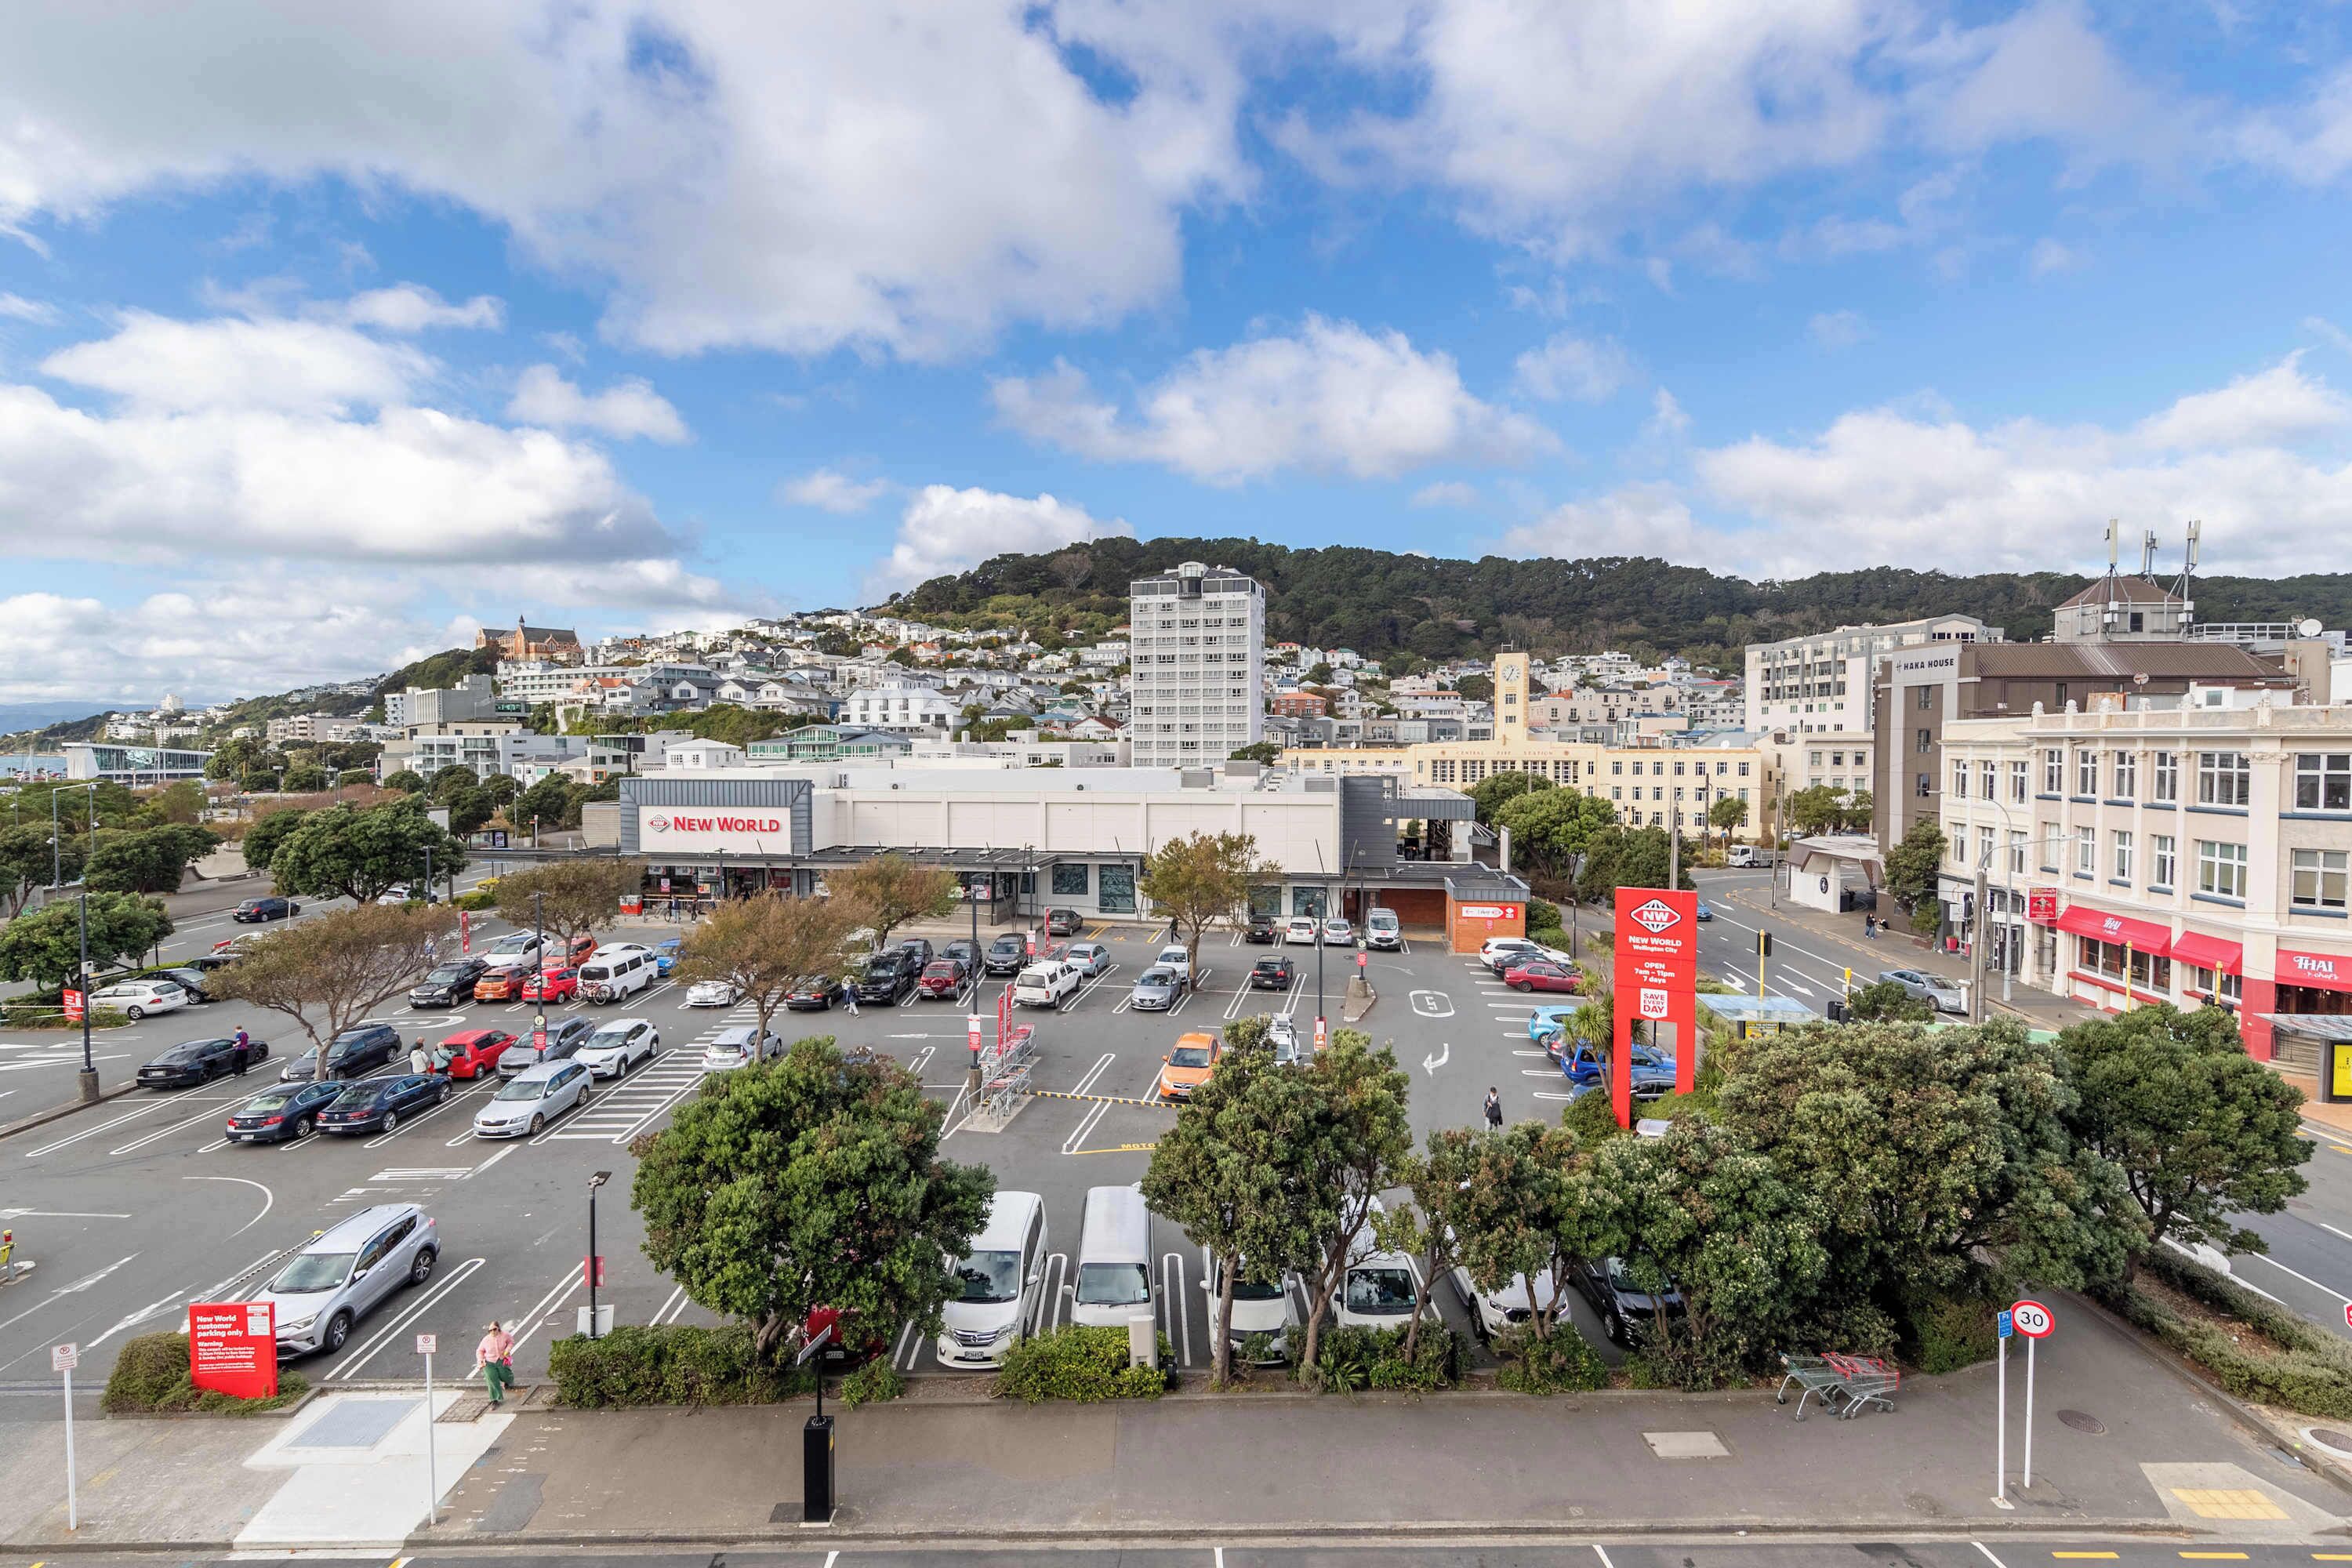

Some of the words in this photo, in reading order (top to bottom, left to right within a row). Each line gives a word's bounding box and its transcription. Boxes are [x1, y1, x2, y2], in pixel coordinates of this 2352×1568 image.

[1904, 662, 1925, 670] HAKA
[1928, 659, 1954, 668] HOUSE
[673, 816, 713, 832] NEW
[717, 817, 780, 833] WORLD
[1642, 910, 1669, 922] NW
[1628, 935, 1649, 944] NEW
[1650, 937, 1682, 947] WORLD
[1644, 961, 1665, 970] OPEN
[2293, 956, 2334, 972] THAI
[1657, 969, 1675, 978] 11pm
[1643, 993, 1665, 1001] SAVE
[1643, 1004, 1664, 1013] DAY
[2020, 1312, 2043, 1327] 30
[197, 1330, 226, 1338] parking
